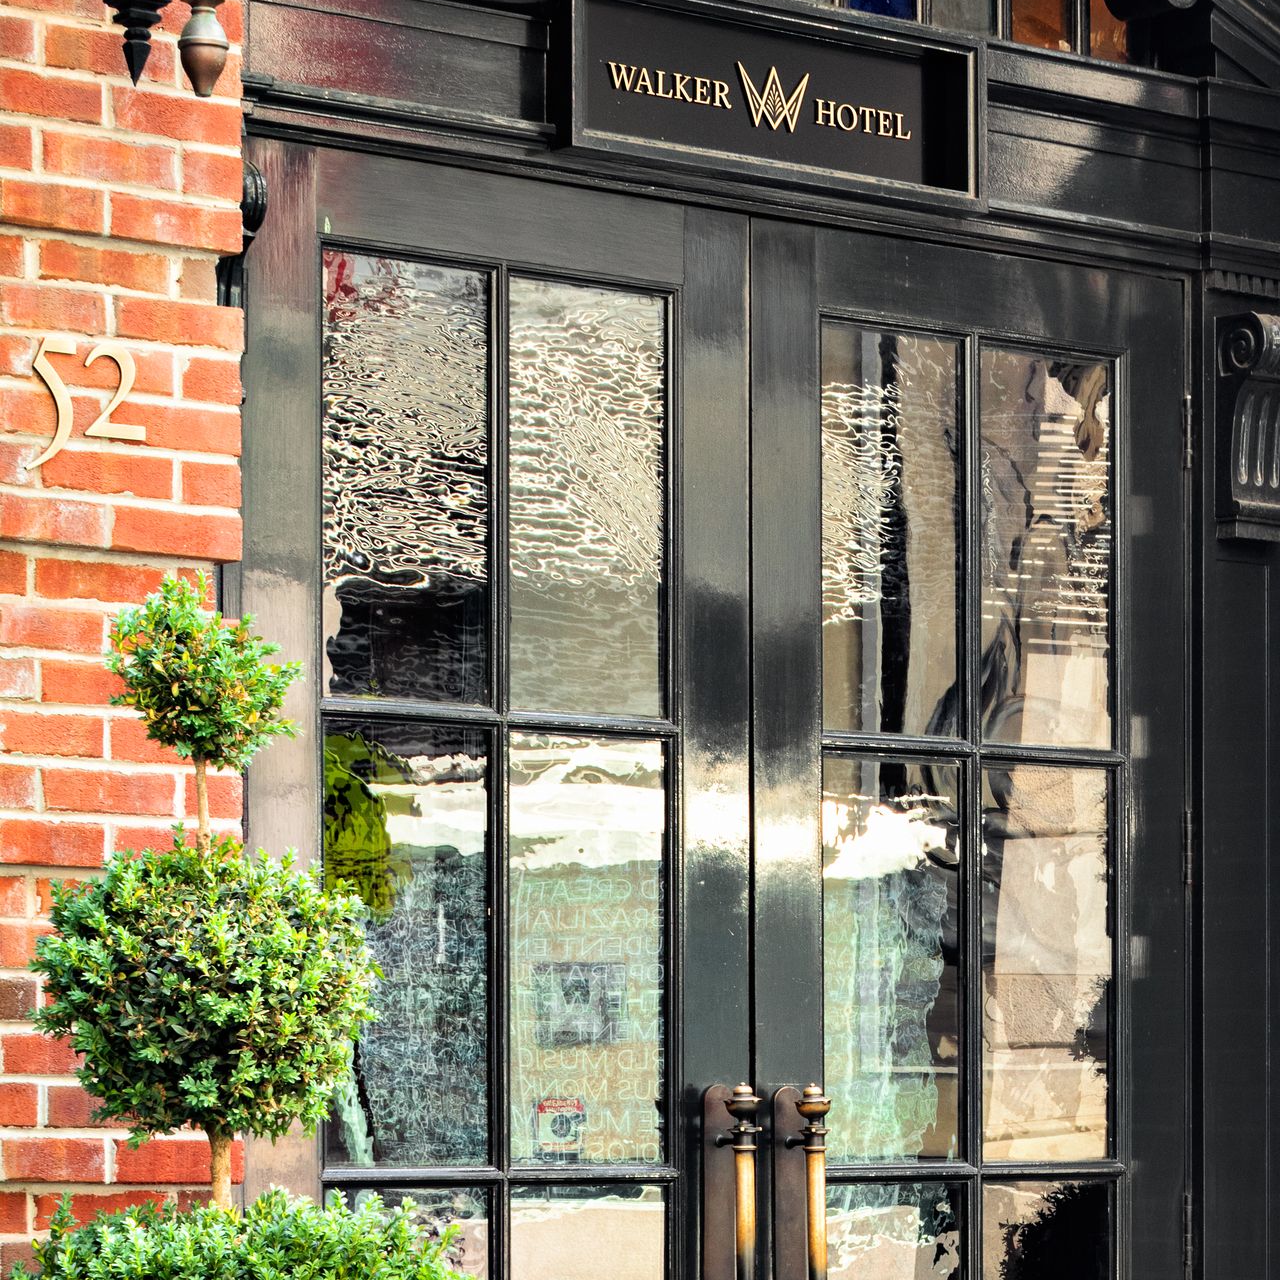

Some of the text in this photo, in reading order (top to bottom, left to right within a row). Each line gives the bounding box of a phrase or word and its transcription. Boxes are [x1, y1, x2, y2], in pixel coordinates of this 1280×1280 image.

[608, 61, 732, 109] WALKER
[815, 98, 912, 140] HOTEL
[25, 336, 147, 470] 52
